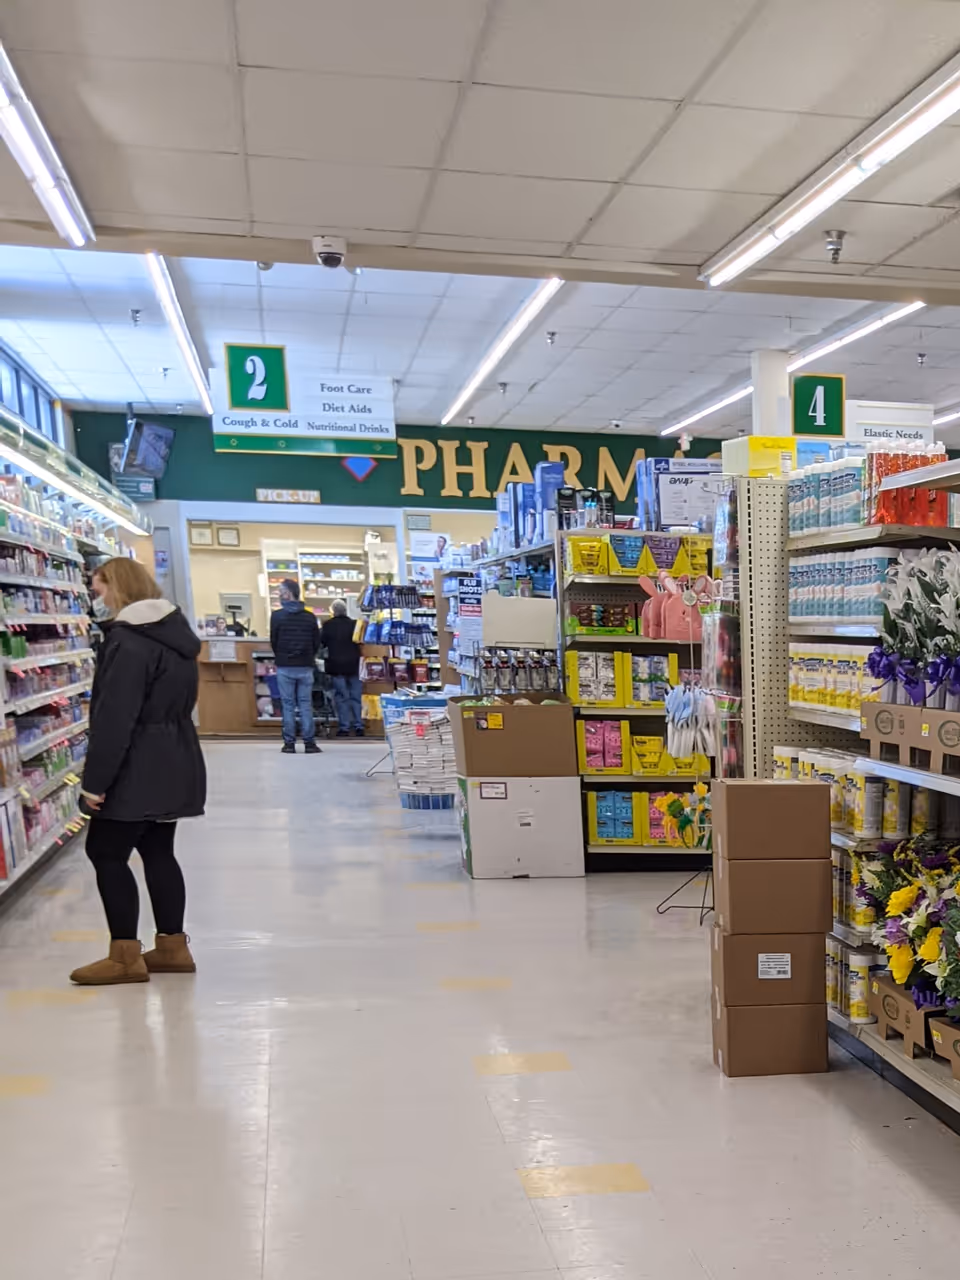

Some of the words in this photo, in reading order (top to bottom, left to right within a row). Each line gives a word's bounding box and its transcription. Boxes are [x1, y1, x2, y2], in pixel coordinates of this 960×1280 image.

[245, 355, 268, 400] 2
[320, 383, 344, 393] Foot
[347, 384, 372, 394] Care
[322, 403, 345, 413] Diet
[348, 404, 372, 414] Aids
[808, 385, 827, 426] 4
[222, 417, 257, 429] Cough
[261, 418, 270, 427] &
[273, 418, 298, 428] Cold
[307, 422, 356, 432] Nutritional
[359, 423, 389, 434] Drinks
[863, 428, 893, 439] Elastic
[895, 430, 924, 439] Needs
